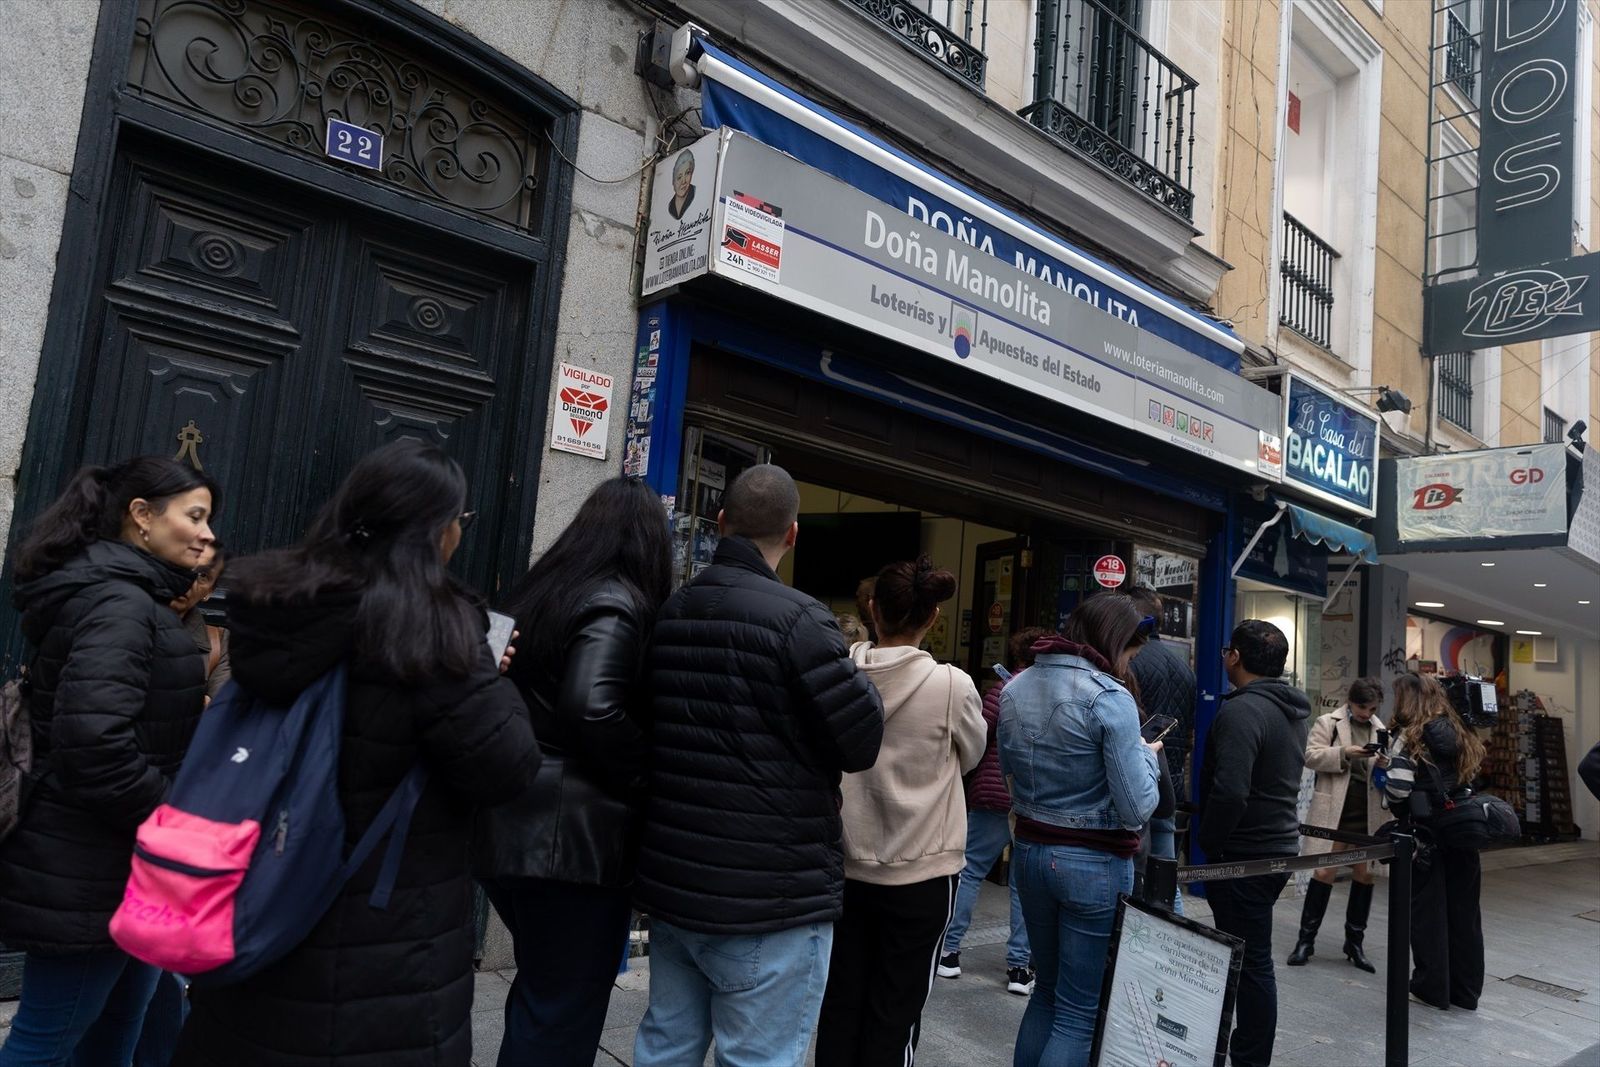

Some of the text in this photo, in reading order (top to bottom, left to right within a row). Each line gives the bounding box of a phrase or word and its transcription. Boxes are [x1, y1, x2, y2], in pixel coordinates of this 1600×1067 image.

[338, 130, 372, 160] 22
[729, 200, 744, 211] ZONA
[726, 251, 745, 266] 24h
[752, 241, 780, 257] LASSER
[864, 210, 938, 276] Doña
[945, 248, 1051, 326] Manolita
[870, 284, 948, 335] Loterías y
[979, 329, 1101, 393] Apuestas del Estado
[1104, 341, 1225, 404] www.loteriamanolita.com
[563, 366, 611, 388] VIGILADO
[1298, 402, 1366, 458] La Casa del
[1288, 432, 1370, 496] BACALAO
[1510, 468, 1544, 485] GD
[1102, 559, 1120, 570] +18
